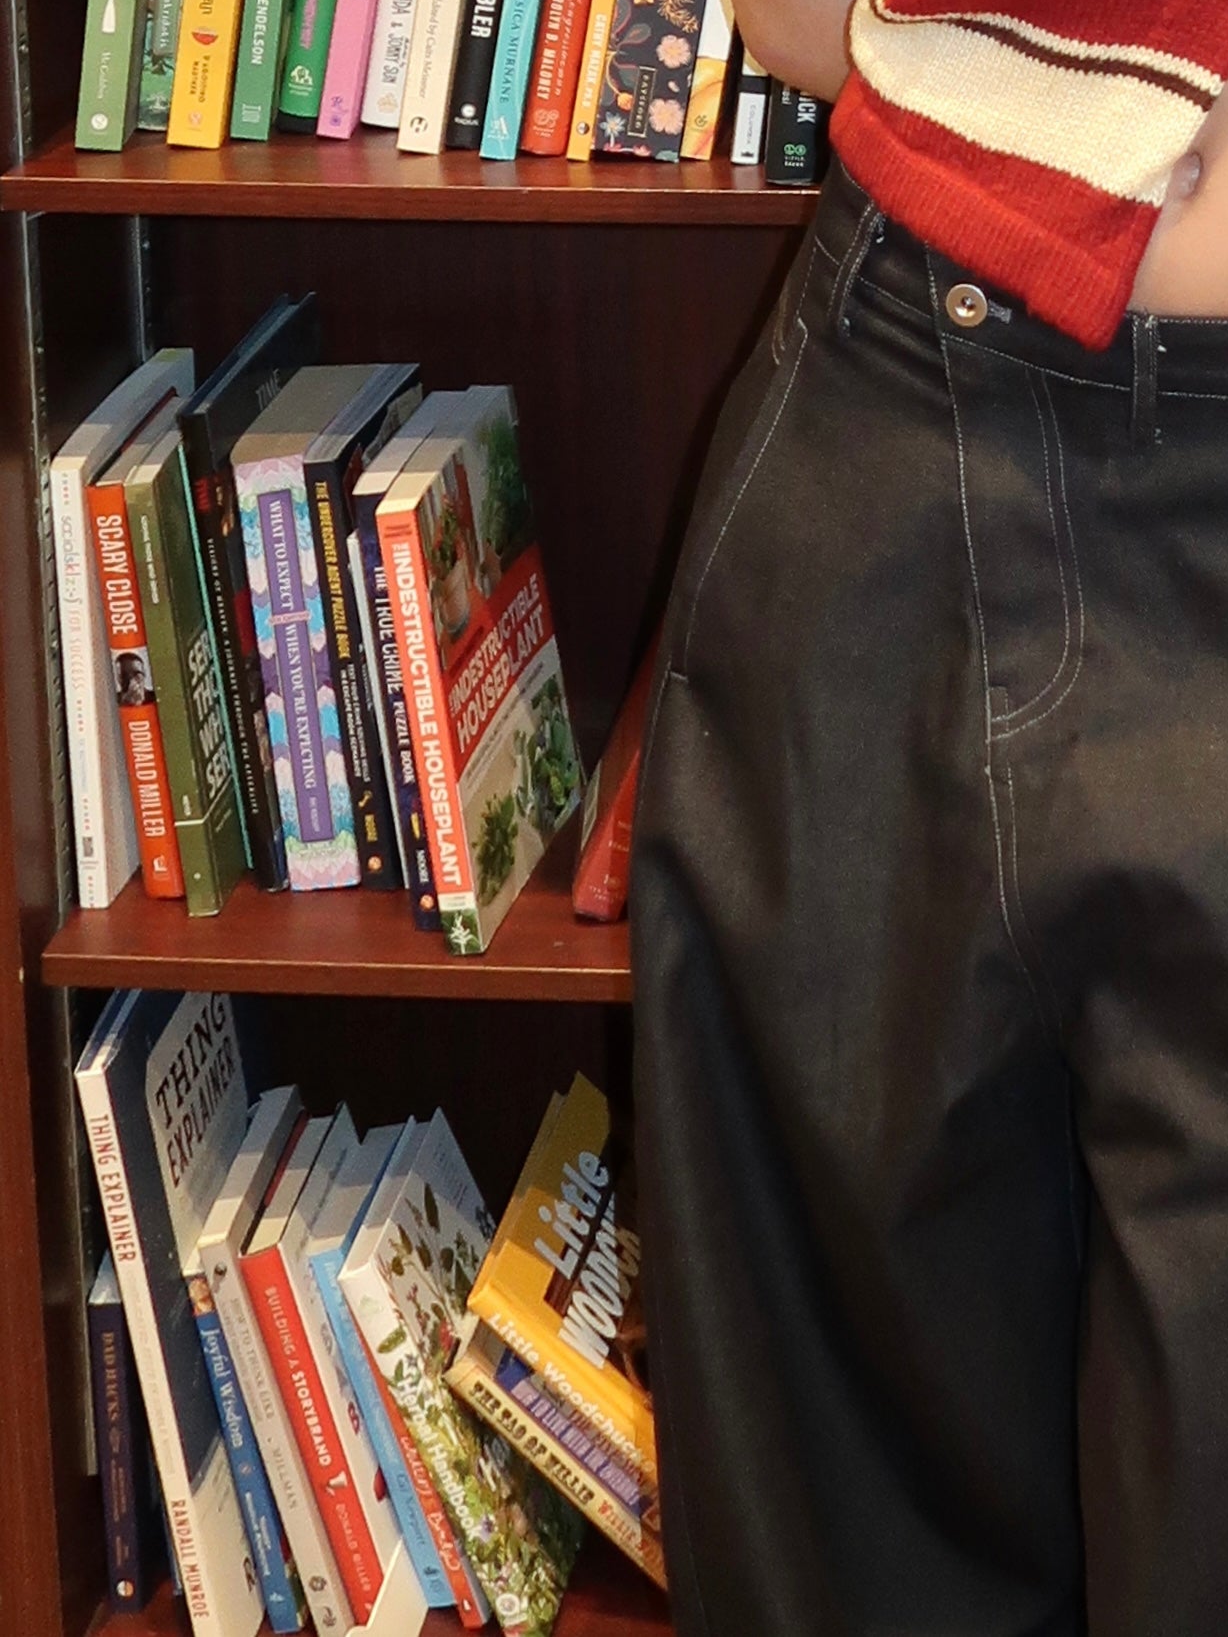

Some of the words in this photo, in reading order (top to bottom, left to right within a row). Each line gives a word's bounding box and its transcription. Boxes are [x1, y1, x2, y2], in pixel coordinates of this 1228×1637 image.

[97, 514, 130, 575] SCARY
[107, 578, 139, 636] CLOSE
[293, 715, 318, 790] EXPECTING
[391, 550, 434, 738] INDESTRUCTIBLE
[424, 739, 464, 886] HOUSEPLANT
[101, 1172, 136, 1262] EXPLAINER
[291, 1371, 334, 1466] STORYBRAND
[427, 1443, 480, 1545] Handbook
